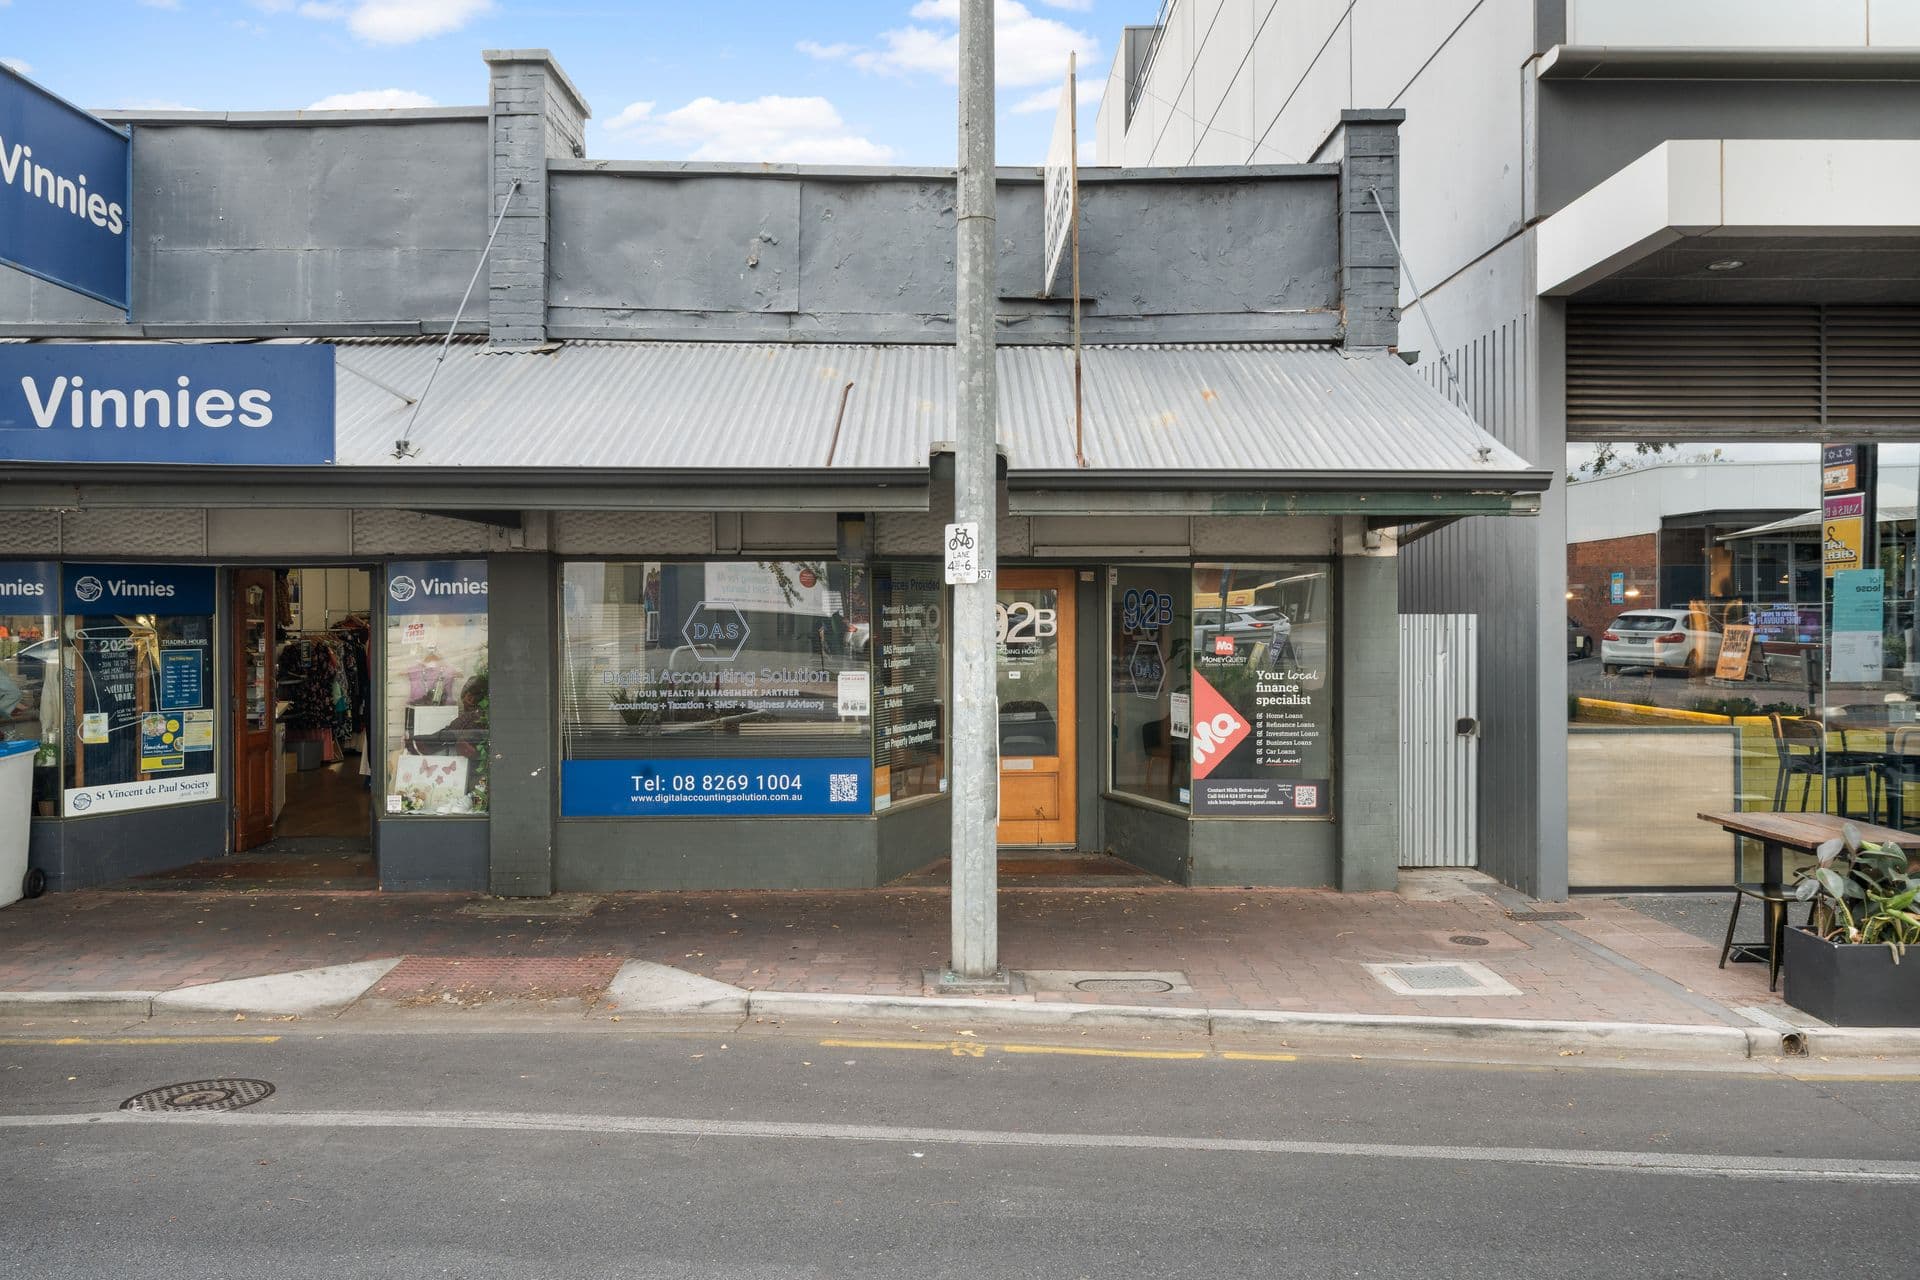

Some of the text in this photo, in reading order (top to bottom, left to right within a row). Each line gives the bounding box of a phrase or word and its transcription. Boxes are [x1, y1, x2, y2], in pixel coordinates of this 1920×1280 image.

[0, 135, 123, 235] Vinnies
[22, 375, 273, 428] Vinnies
[953, 551, 970, 559] LANE
[108, 579, 175, 597] Vinnies
[420, 577, 488, 595] Vinnies
[1123, 588, 1173, 630] 92B
[693, 622, 739, 640] DAS
[100, 638, 134, 653] 2025
[603, 667, 830, 688] Digital Accounting Solution
[1256, 669, 1319, 680] Your local
[633, 688, 800, 697] YOUR WEALTH MANAGEMENT PARTNER
[1256, 682, 1299, 693] finance
[608, 701, 659, 711] Accounting
[667, 701, 704, 710] Taxation
[714, 700, 738, 709] SMSF
[747, 700, 785, 709] Business
[786, 700, 825, 711] Advisory
[1256, 694, 1312, 707] specialist
[96, 780, 209, 800] St Vincent de Paul Society
[631, 774, 802, 791] Tel: 08 8269 1004
[631, 792, 803, 803] www.digitalaccountingsolution.com.au
